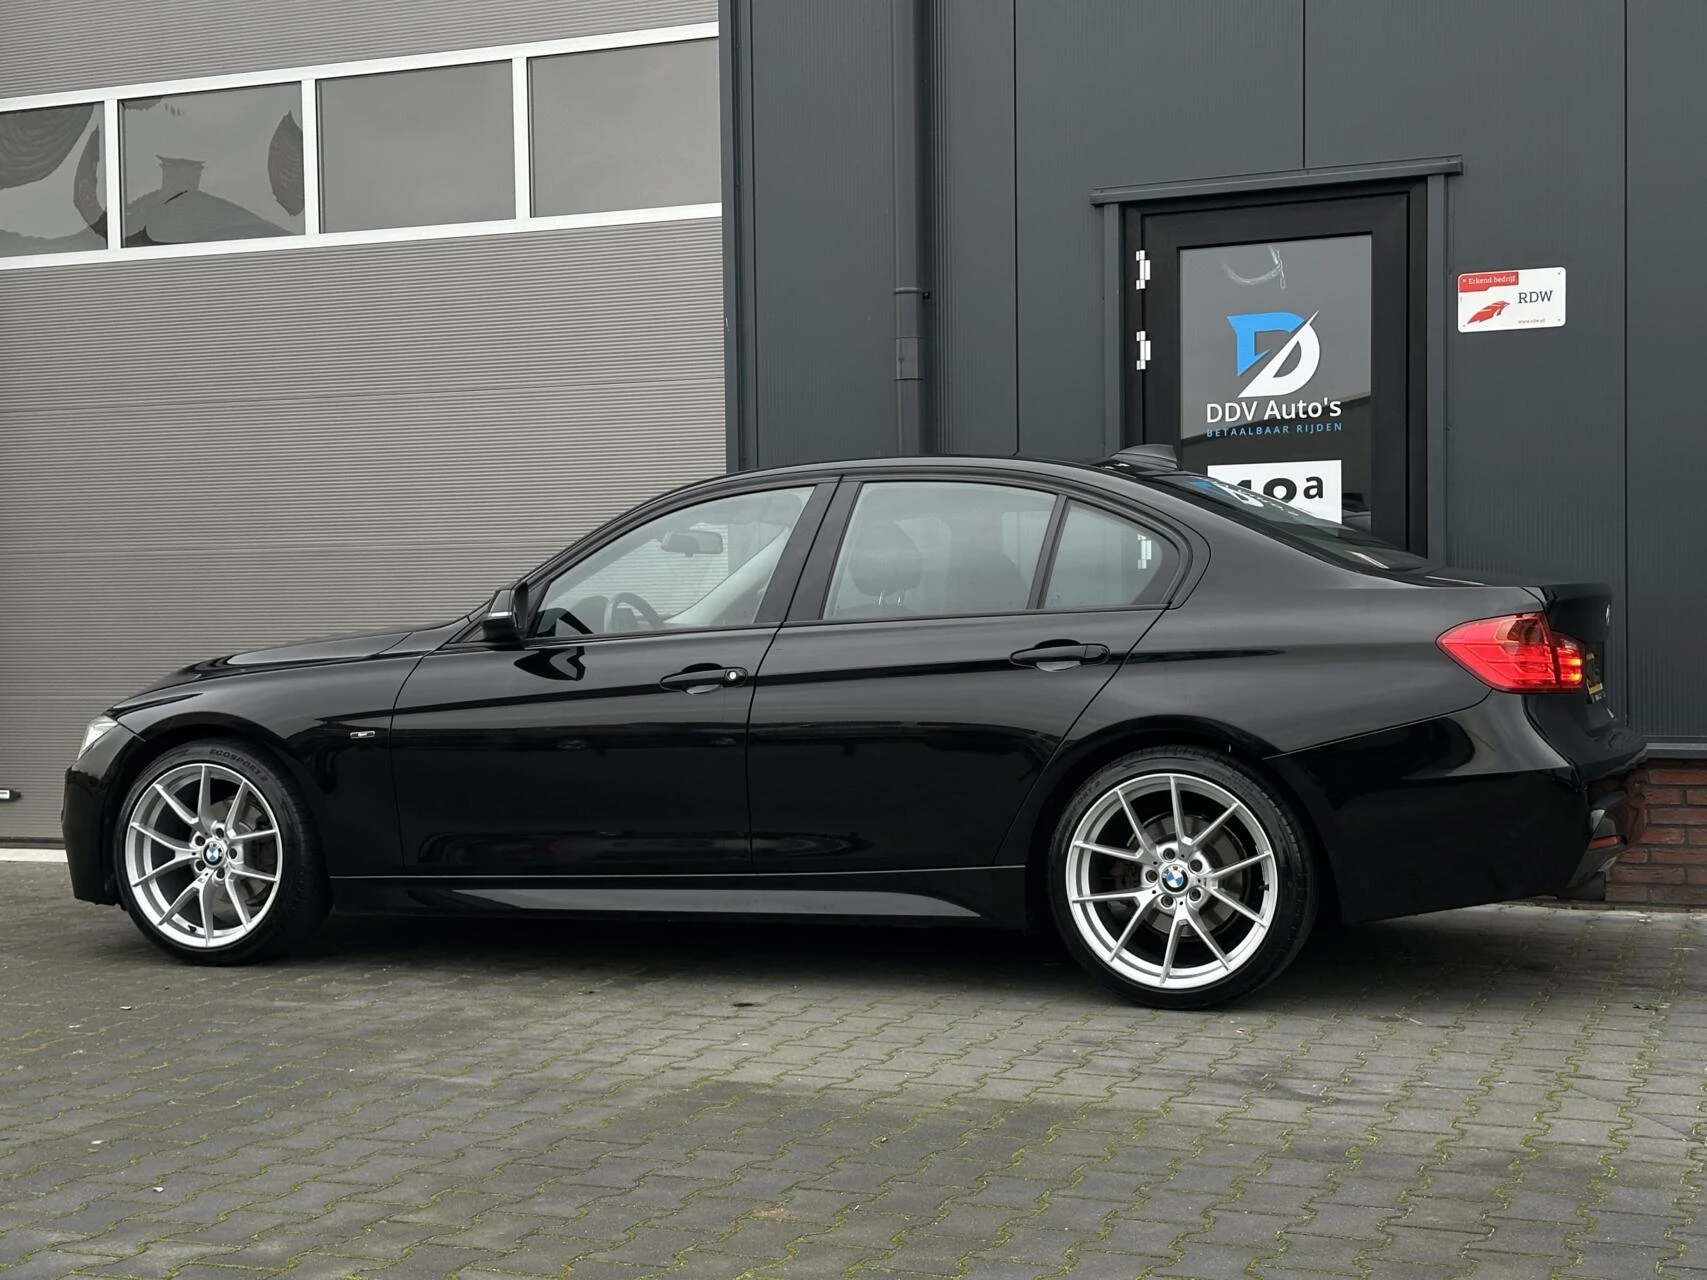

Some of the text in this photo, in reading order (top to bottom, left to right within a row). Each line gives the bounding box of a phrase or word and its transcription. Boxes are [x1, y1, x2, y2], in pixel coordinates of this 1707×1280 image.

[1468, 275, 1516, 285] Erkend bedrijf
[1518, 290, 1554, 304] RDW
[1206, 397, 1342, 423] DDV Auto's
[1206, 422, 1342, 438] BETAALBAAR RIJDEN
